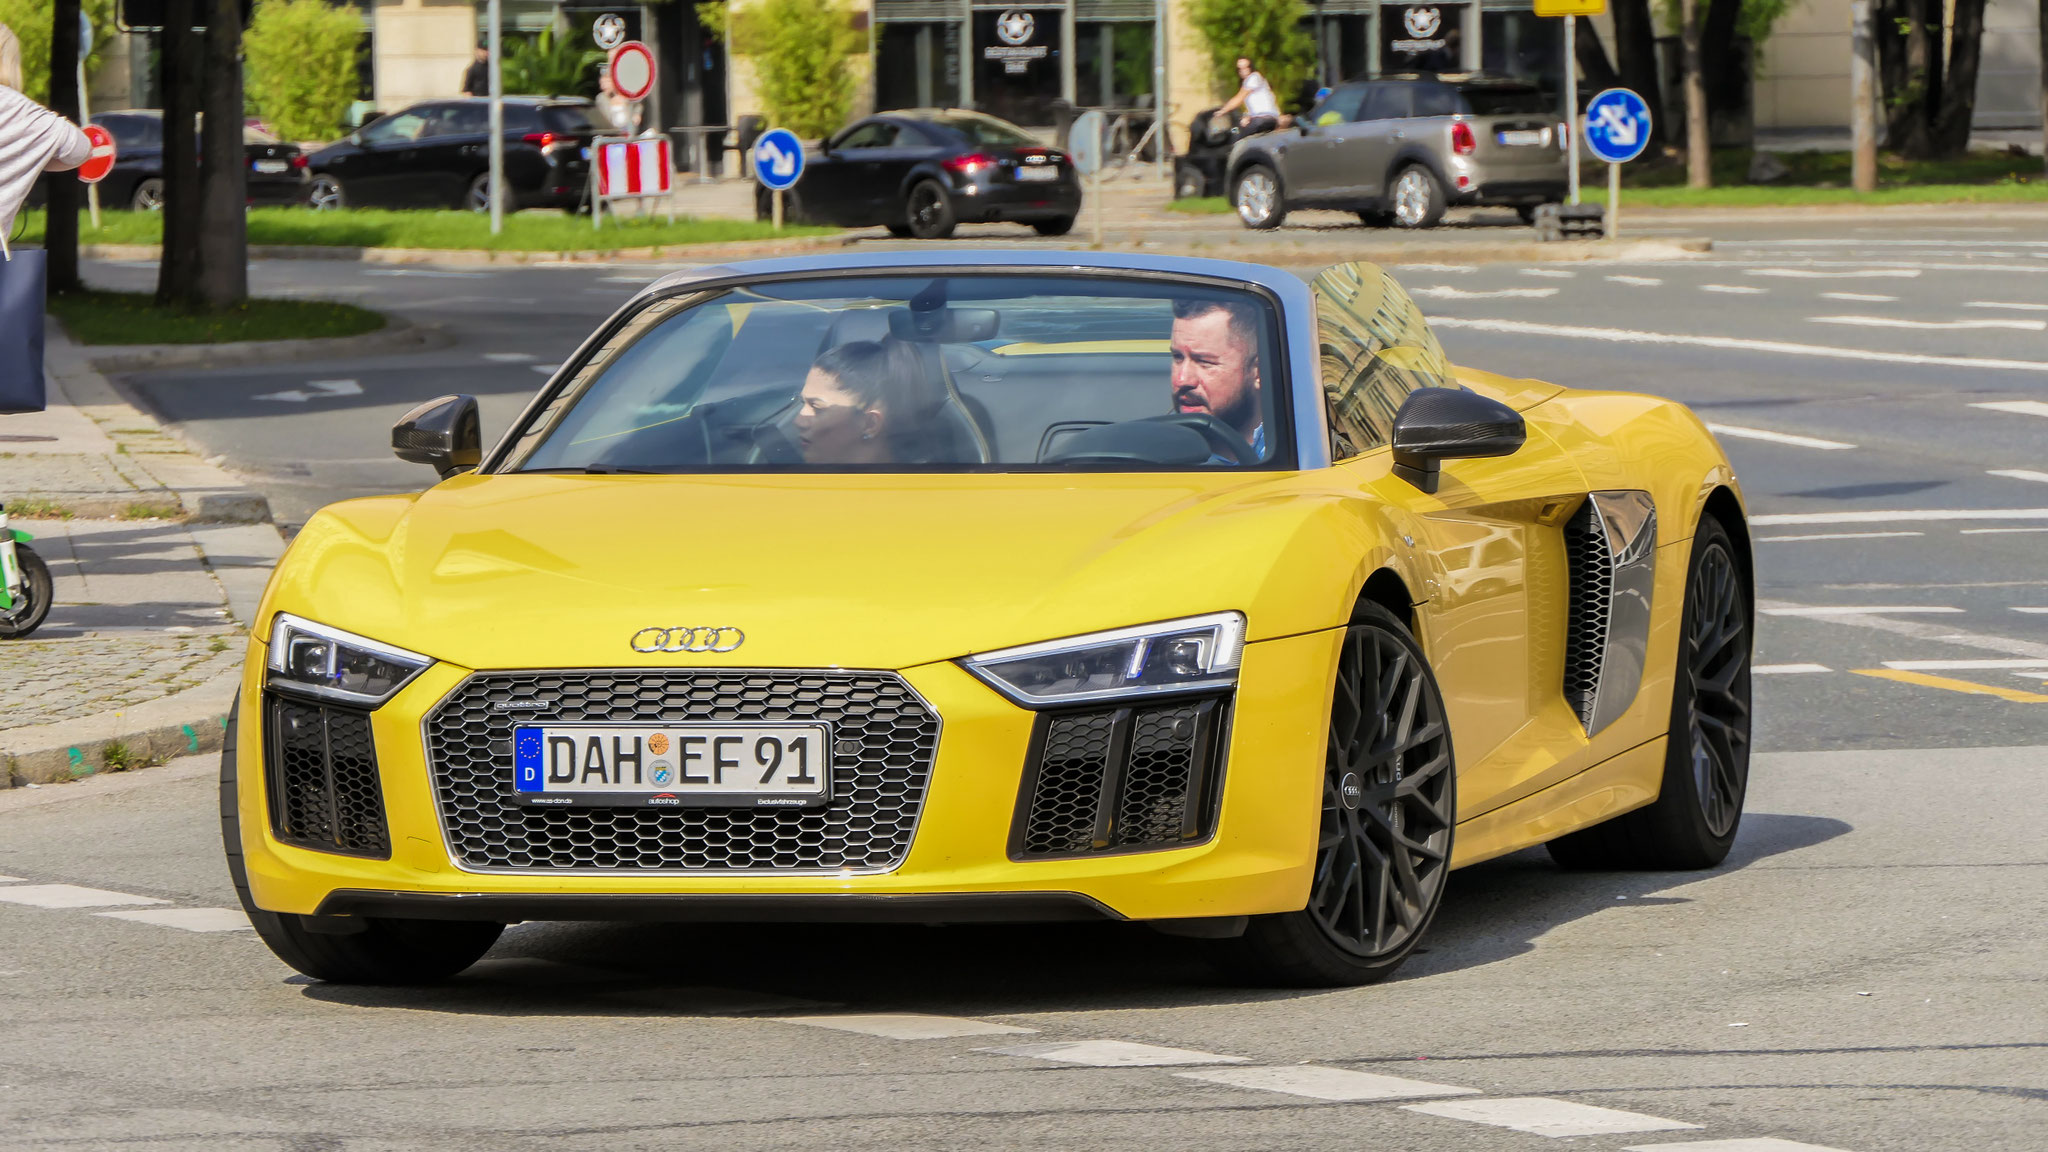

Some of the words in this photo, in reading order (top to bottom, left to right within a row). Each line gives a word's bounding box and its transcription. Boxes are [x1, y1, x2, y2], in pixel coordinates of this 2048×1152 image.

[524, 767, 535, 781] D
[547, 736, 642, 784] DAH
[679, 735, 744, 784] EF
[754, 735, 816, 784] 91
